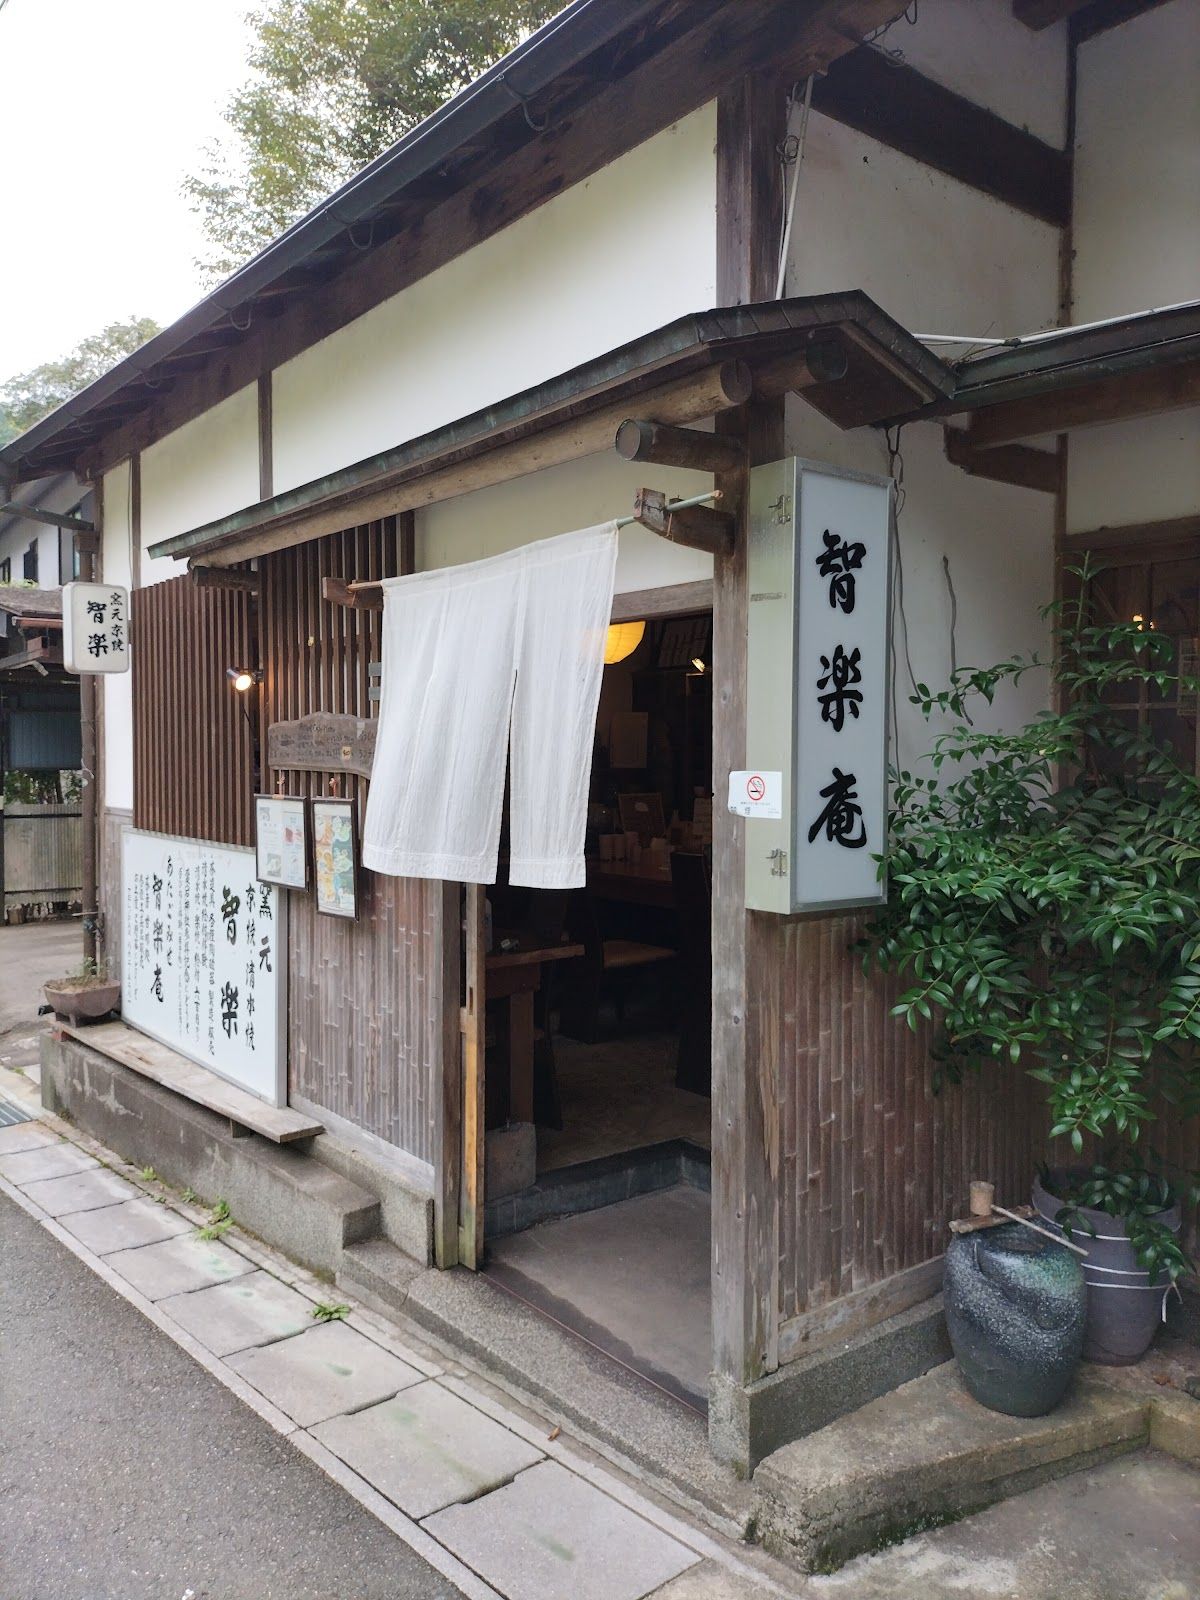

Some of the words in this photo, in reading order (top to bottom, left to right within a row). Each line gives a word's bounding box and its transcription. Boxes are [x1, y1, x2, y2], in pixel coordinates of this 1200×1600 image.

[87, 600, 109, 658] 智楽
[808, 529, 867, 849] 智楽庵
[220, 884, 241, 1040] 智楽
